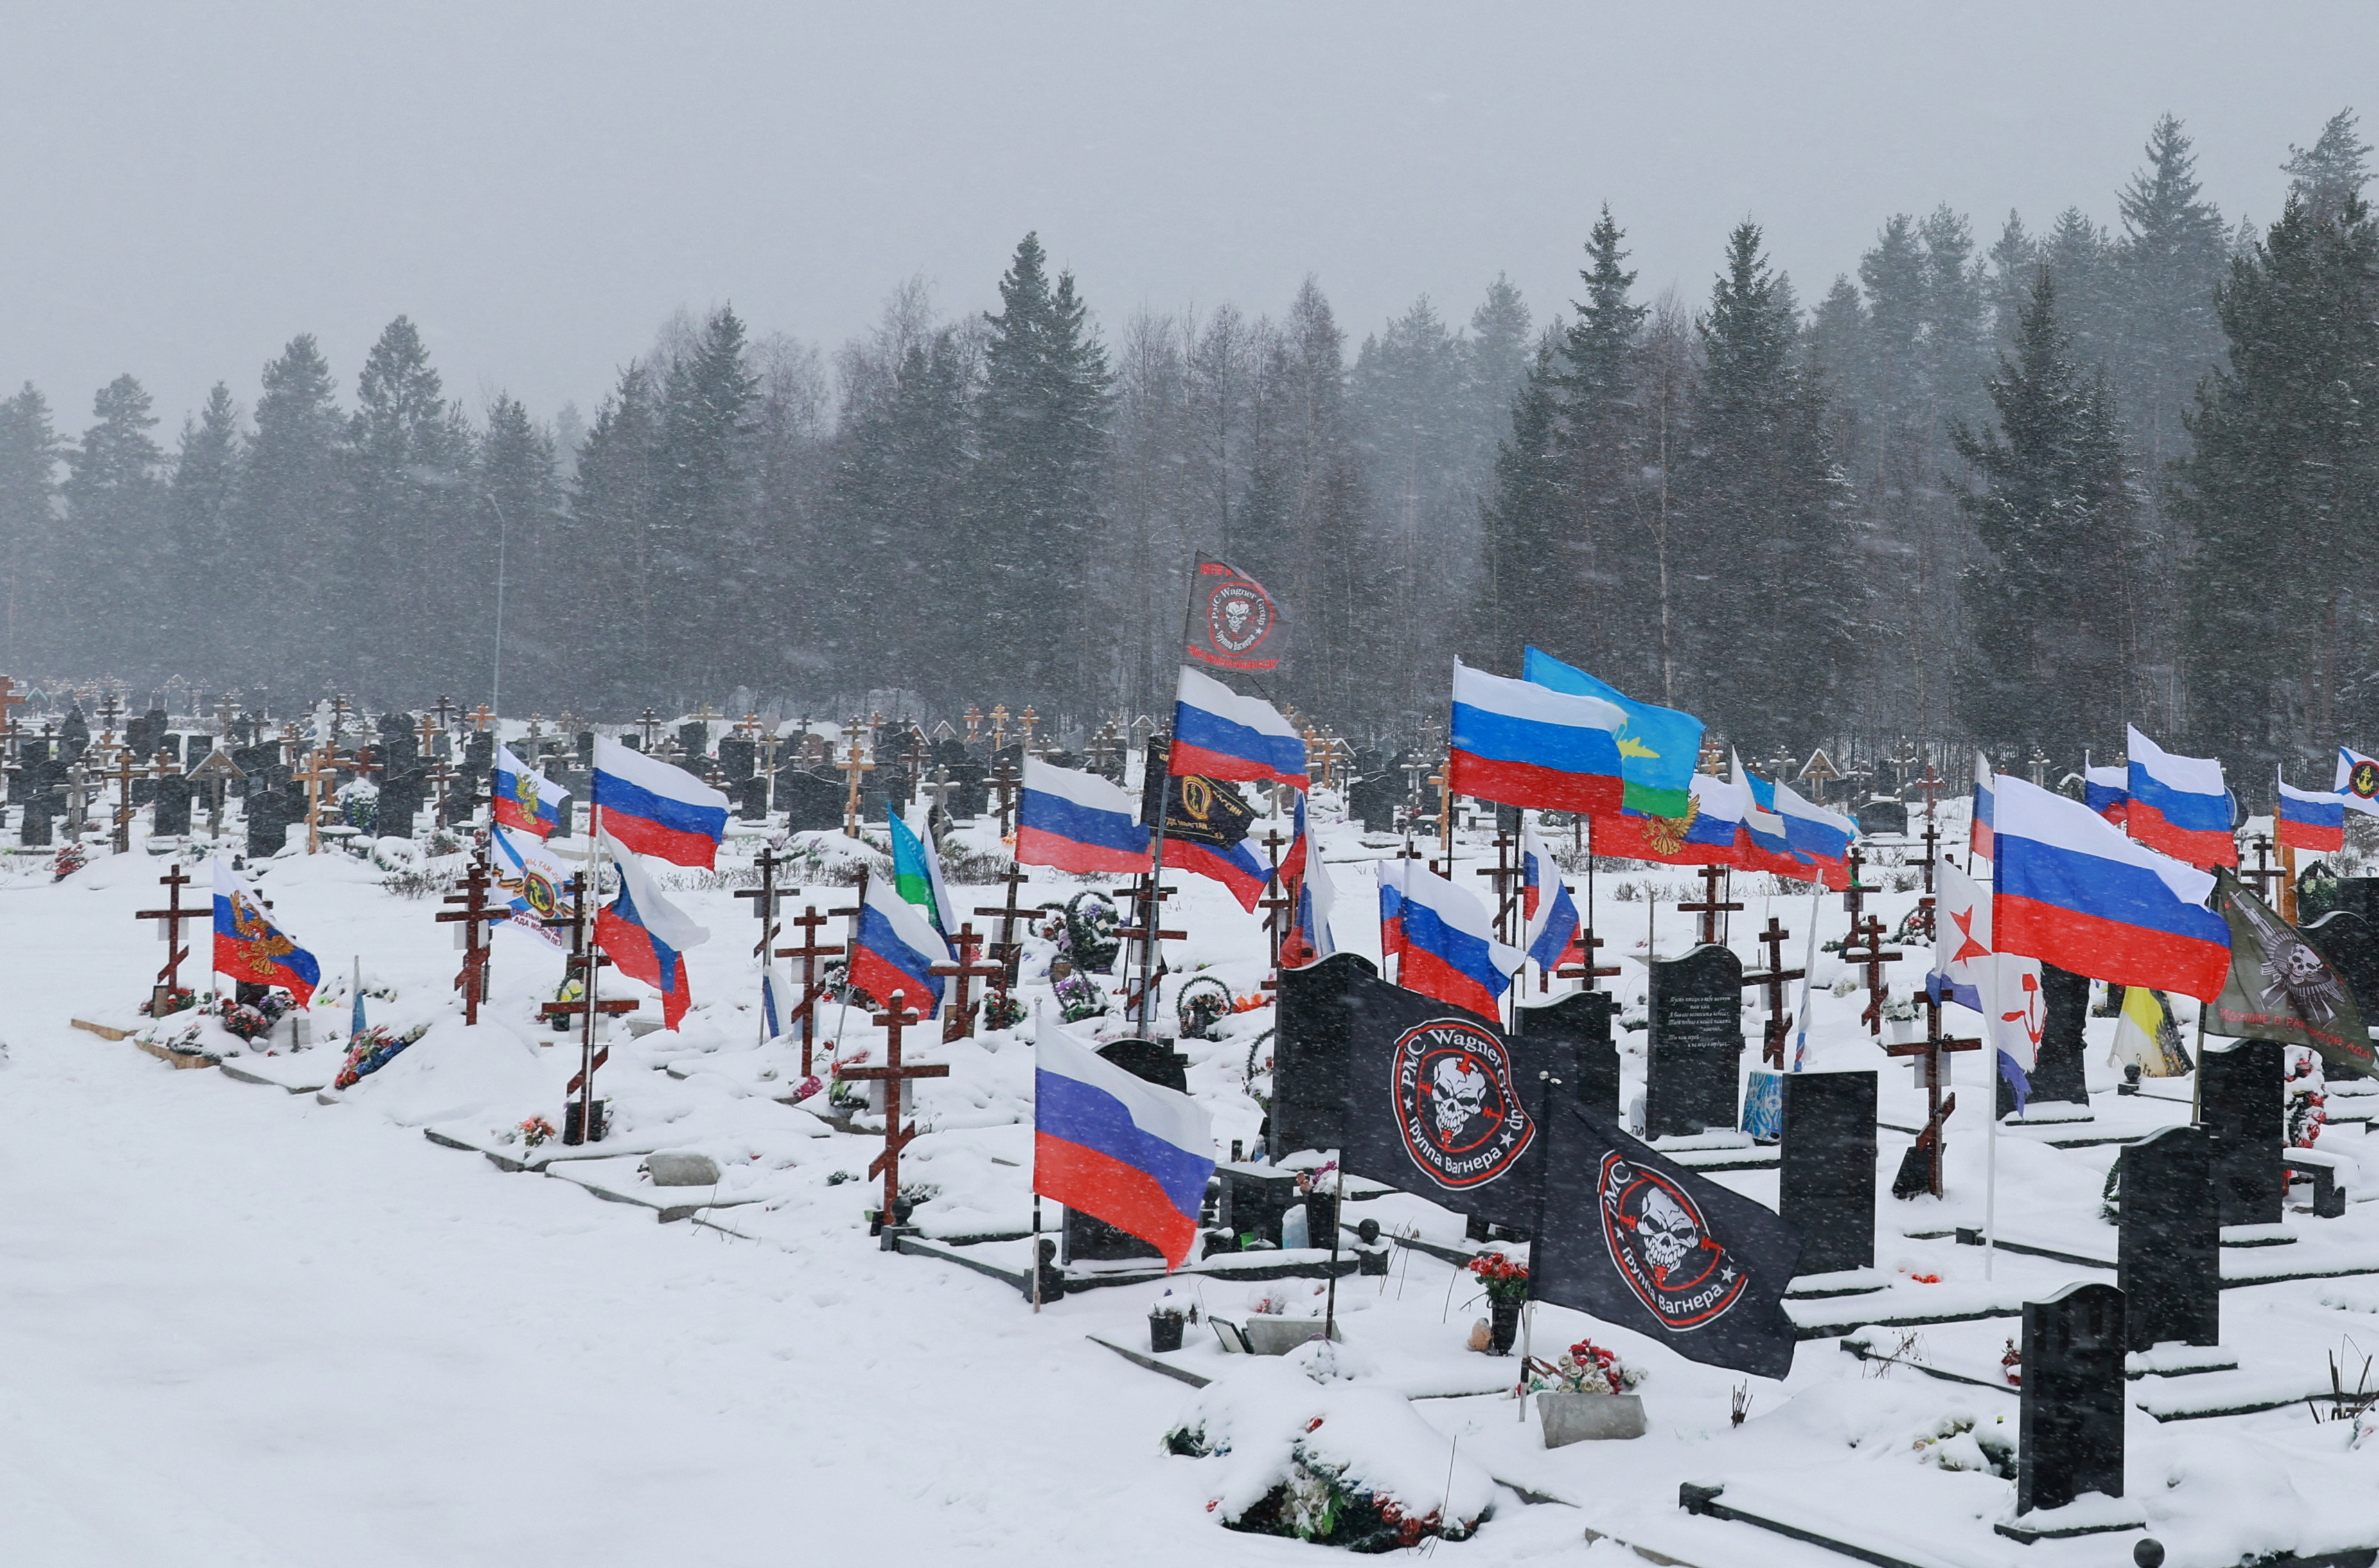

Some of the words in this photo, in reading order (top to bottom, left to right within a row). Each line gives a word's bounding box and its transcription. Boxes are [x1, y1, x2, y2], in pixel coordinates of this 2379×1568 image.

[1220, 587, 1257, 599] Wagner
[1256, 598, 1266, 626] Group
[1216, 630, 1234, 649] Группа
[1401, 1035, 1426, 1089] PMC
[1427, 1029, 1502, 1068] Wagner
[2346, 1042, 2371, 1059] АДА
[1409, 1116, 1442, 1167] Группа
[1446, 1147, 1503, 1174] Вагнера
[1604, 1160, 1631, 1219] MC
[1622, 1247, 1656, 1302] Группа
[1658, 1284, 1724, 1314] Вагнера
